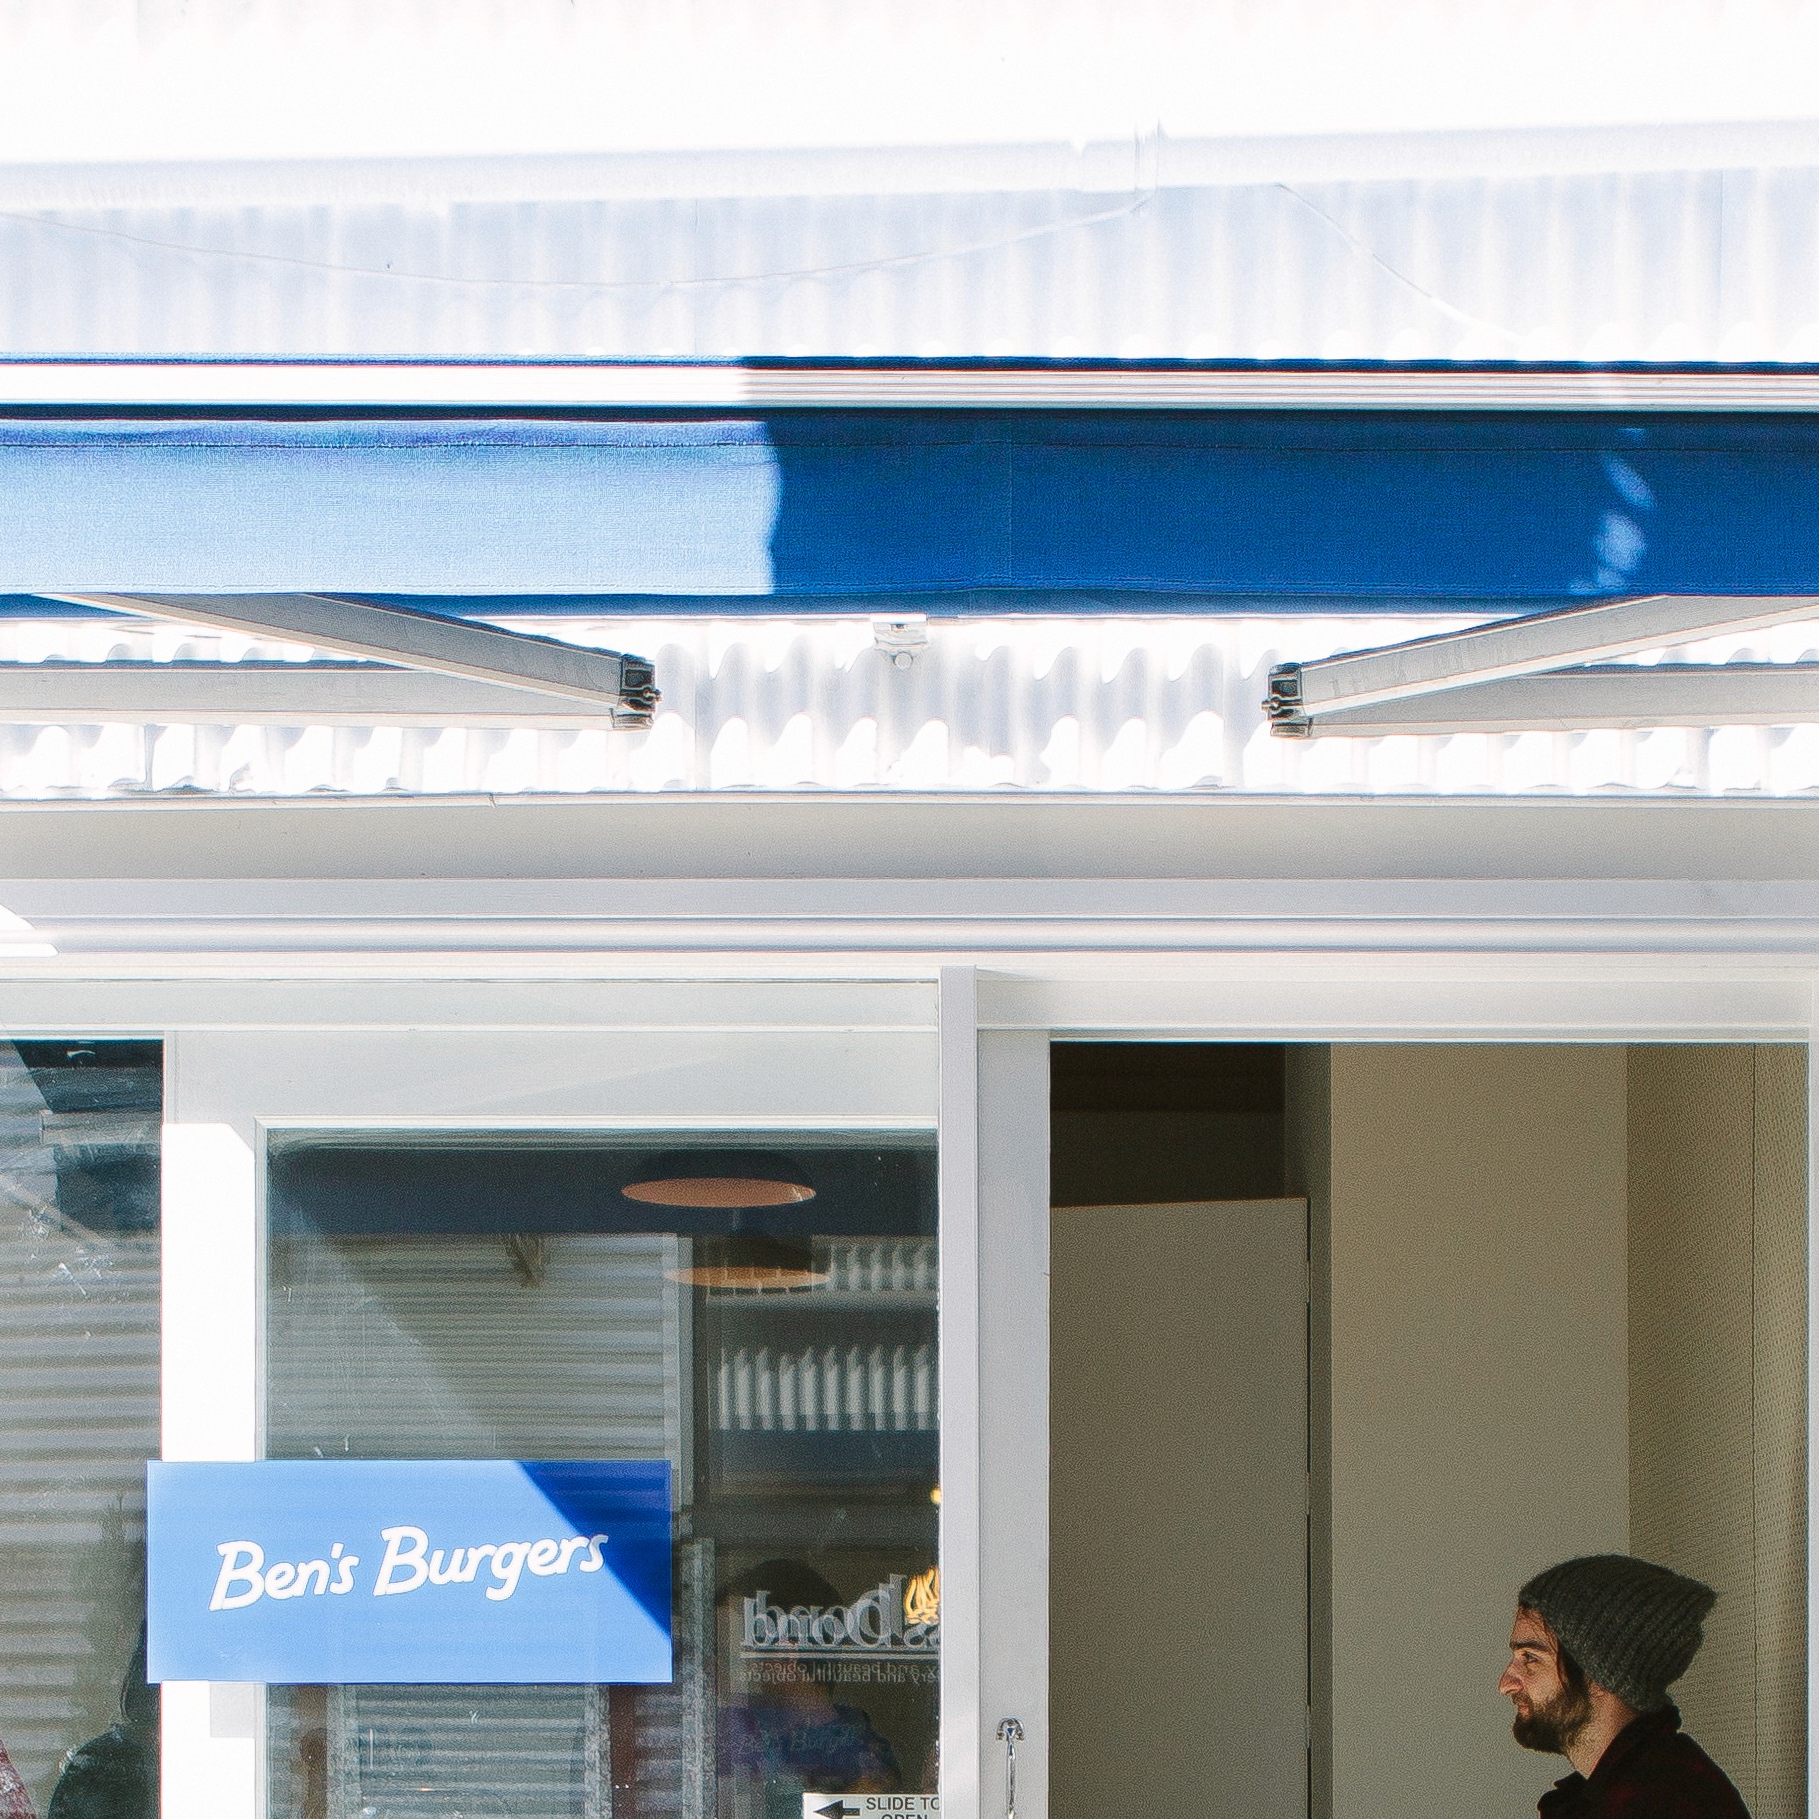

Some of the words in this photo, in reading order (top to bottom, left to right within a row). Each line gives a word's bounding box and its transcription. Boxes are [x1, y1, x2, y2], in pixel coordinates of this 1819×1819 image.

[209, 1540, 360, 1612] Ben's
[373, 1525, 610, 1601] Burgers
[866, 1797, 914, 1811] SLIDE
[919, 1797, 941, 1811] TO
